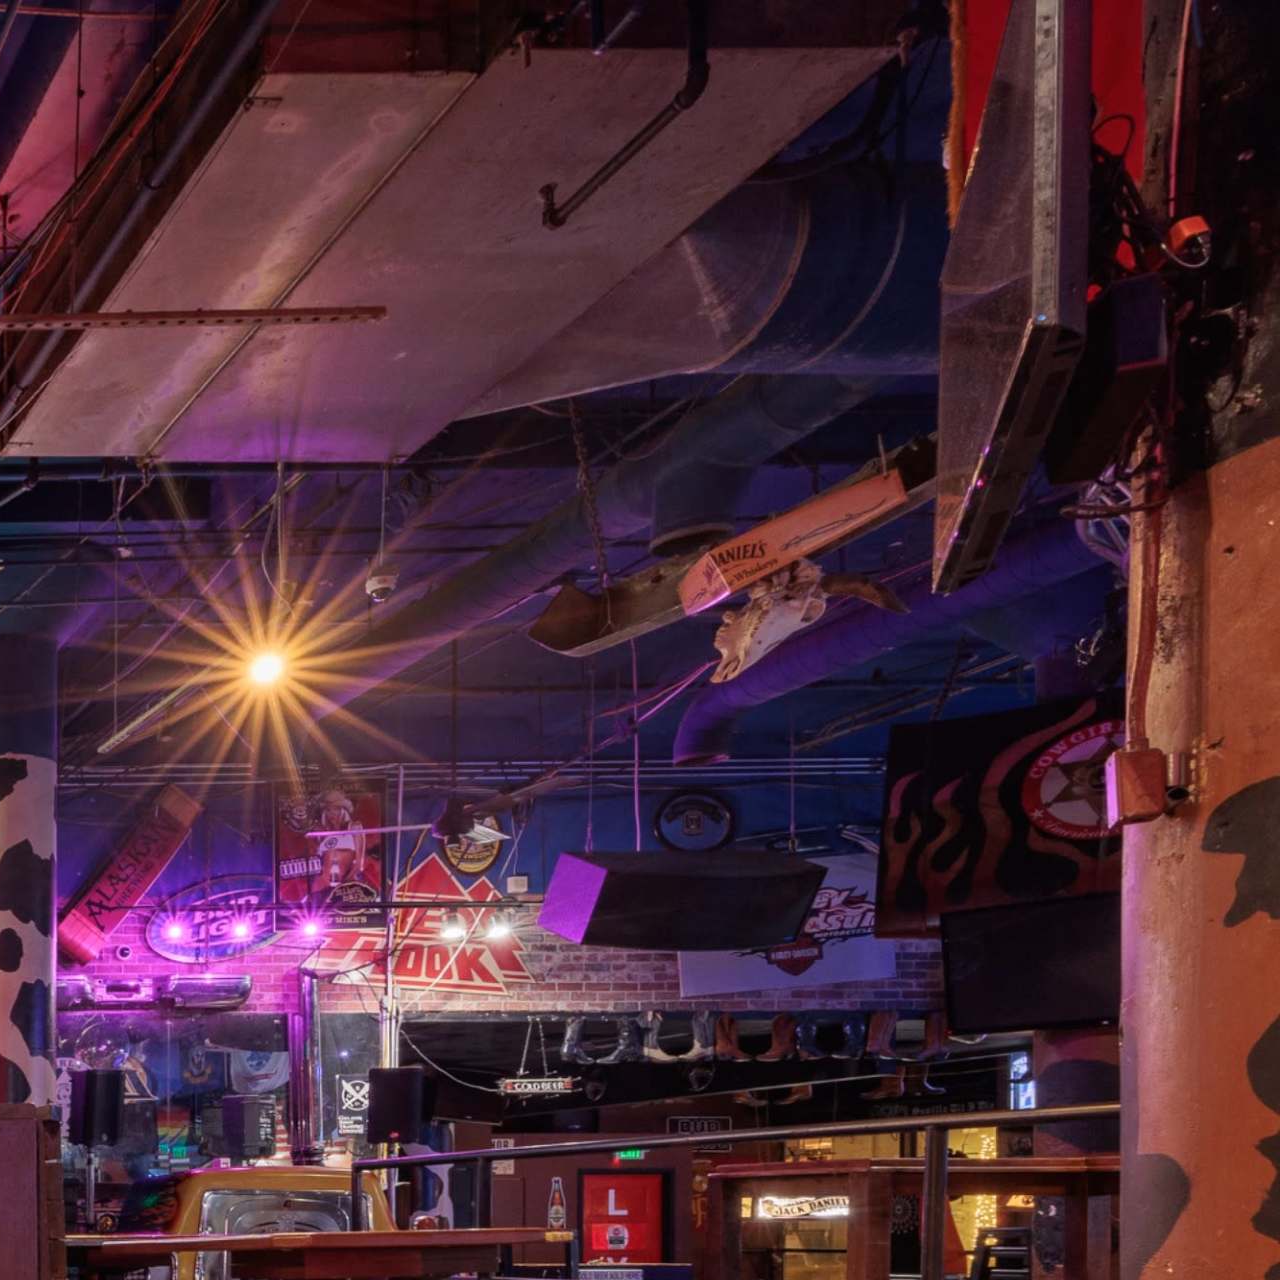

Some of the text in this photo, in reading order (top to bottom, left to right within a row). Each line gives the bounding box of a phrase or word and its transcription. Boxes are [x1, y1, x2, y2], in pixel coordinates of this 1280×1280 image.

[711, 541, 768, 568] DANIEL'S
[514, 1080, 565, 1090] COLD BEER
[776, 1205, 805, 1216] JACK
